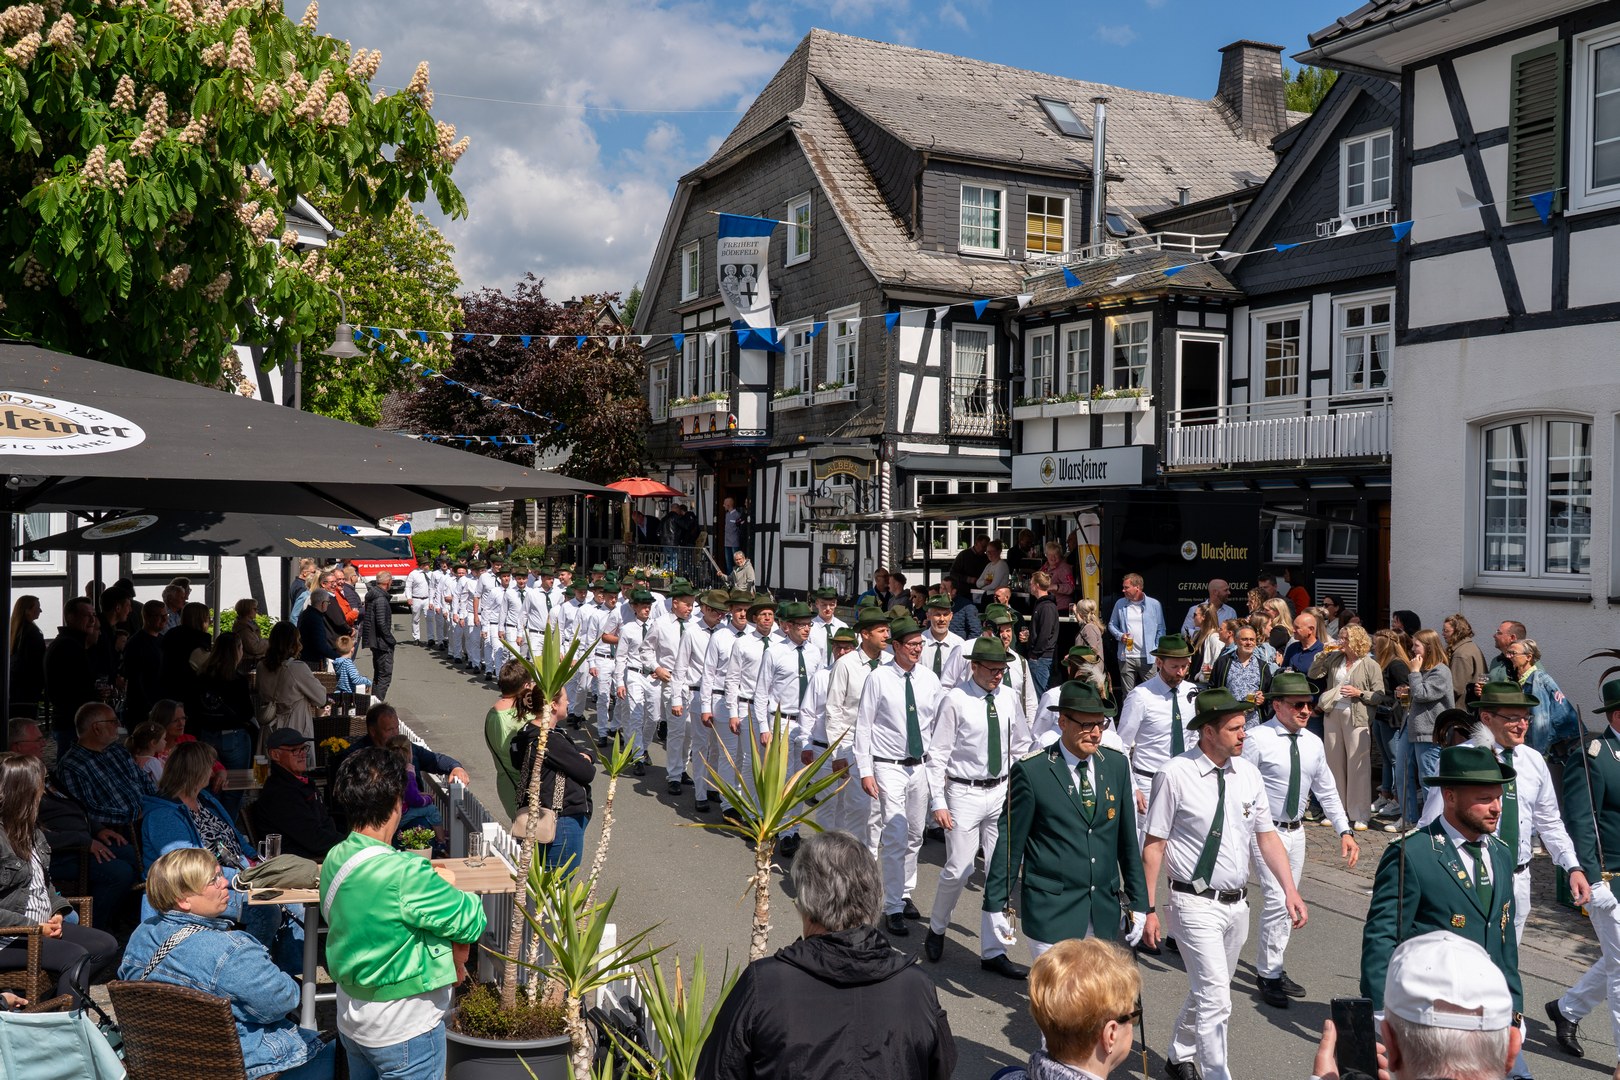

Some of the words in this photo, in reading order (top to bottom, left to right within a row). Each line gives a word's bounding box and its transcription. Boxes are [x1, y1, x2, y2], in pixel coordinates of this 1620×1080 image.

[721, 249, 760, 257] BÖDEFELD
[0, 410, 131, 438] teiner
[47, 439, 112, 450] WAHRE
[827, 461, 859, 473] ALBERS
[1058, 454, 1108, 483] Warsteiner
[1201, 541, 1249, 561] Warsteiner
[1178, 582, 1208, 590] GETRÄN
